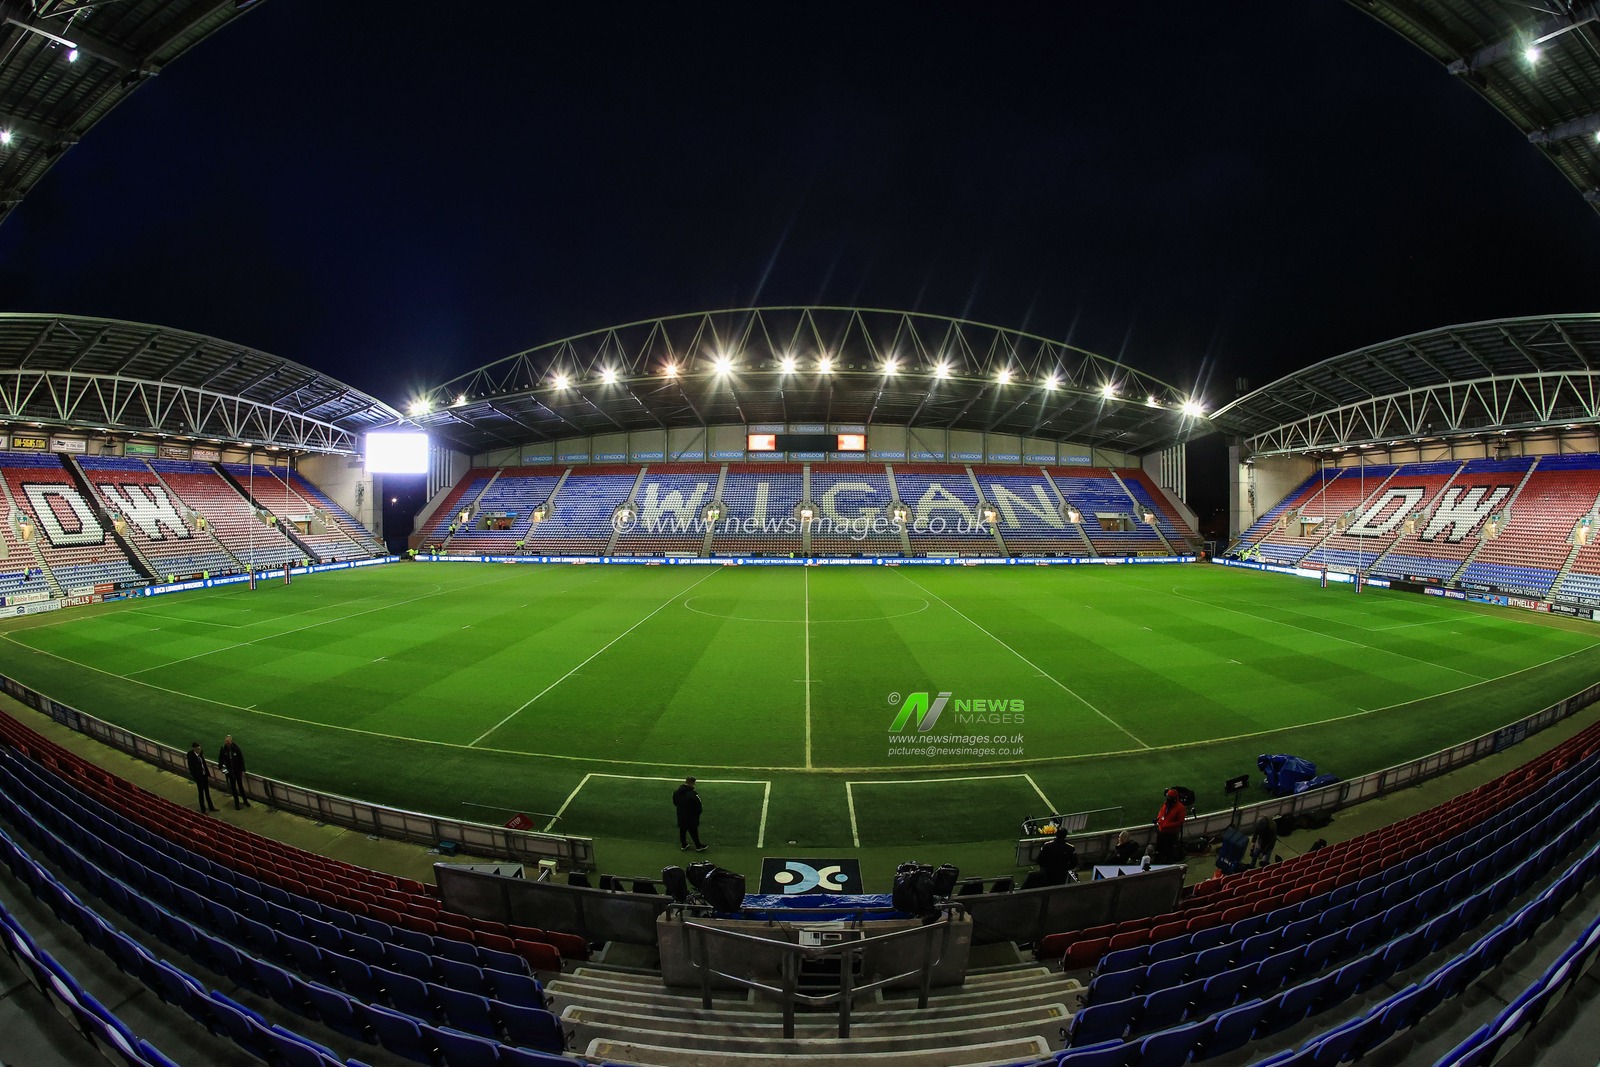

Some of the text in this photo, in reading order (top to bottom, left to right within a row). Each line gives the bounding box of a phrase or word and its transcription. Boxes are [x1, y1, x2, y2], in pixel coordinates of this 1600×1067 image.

[640, 482, 1065, 531] WIGAN
[1445, 591, 1465, 599] BETFRED
[1524, 590, 1541, 598] TOYOTA
[62, 595, 90, 607] BITHELLS
[1508, 597, 1535, 609] BITHELLS
[509, 816, 521, 828] STOP
